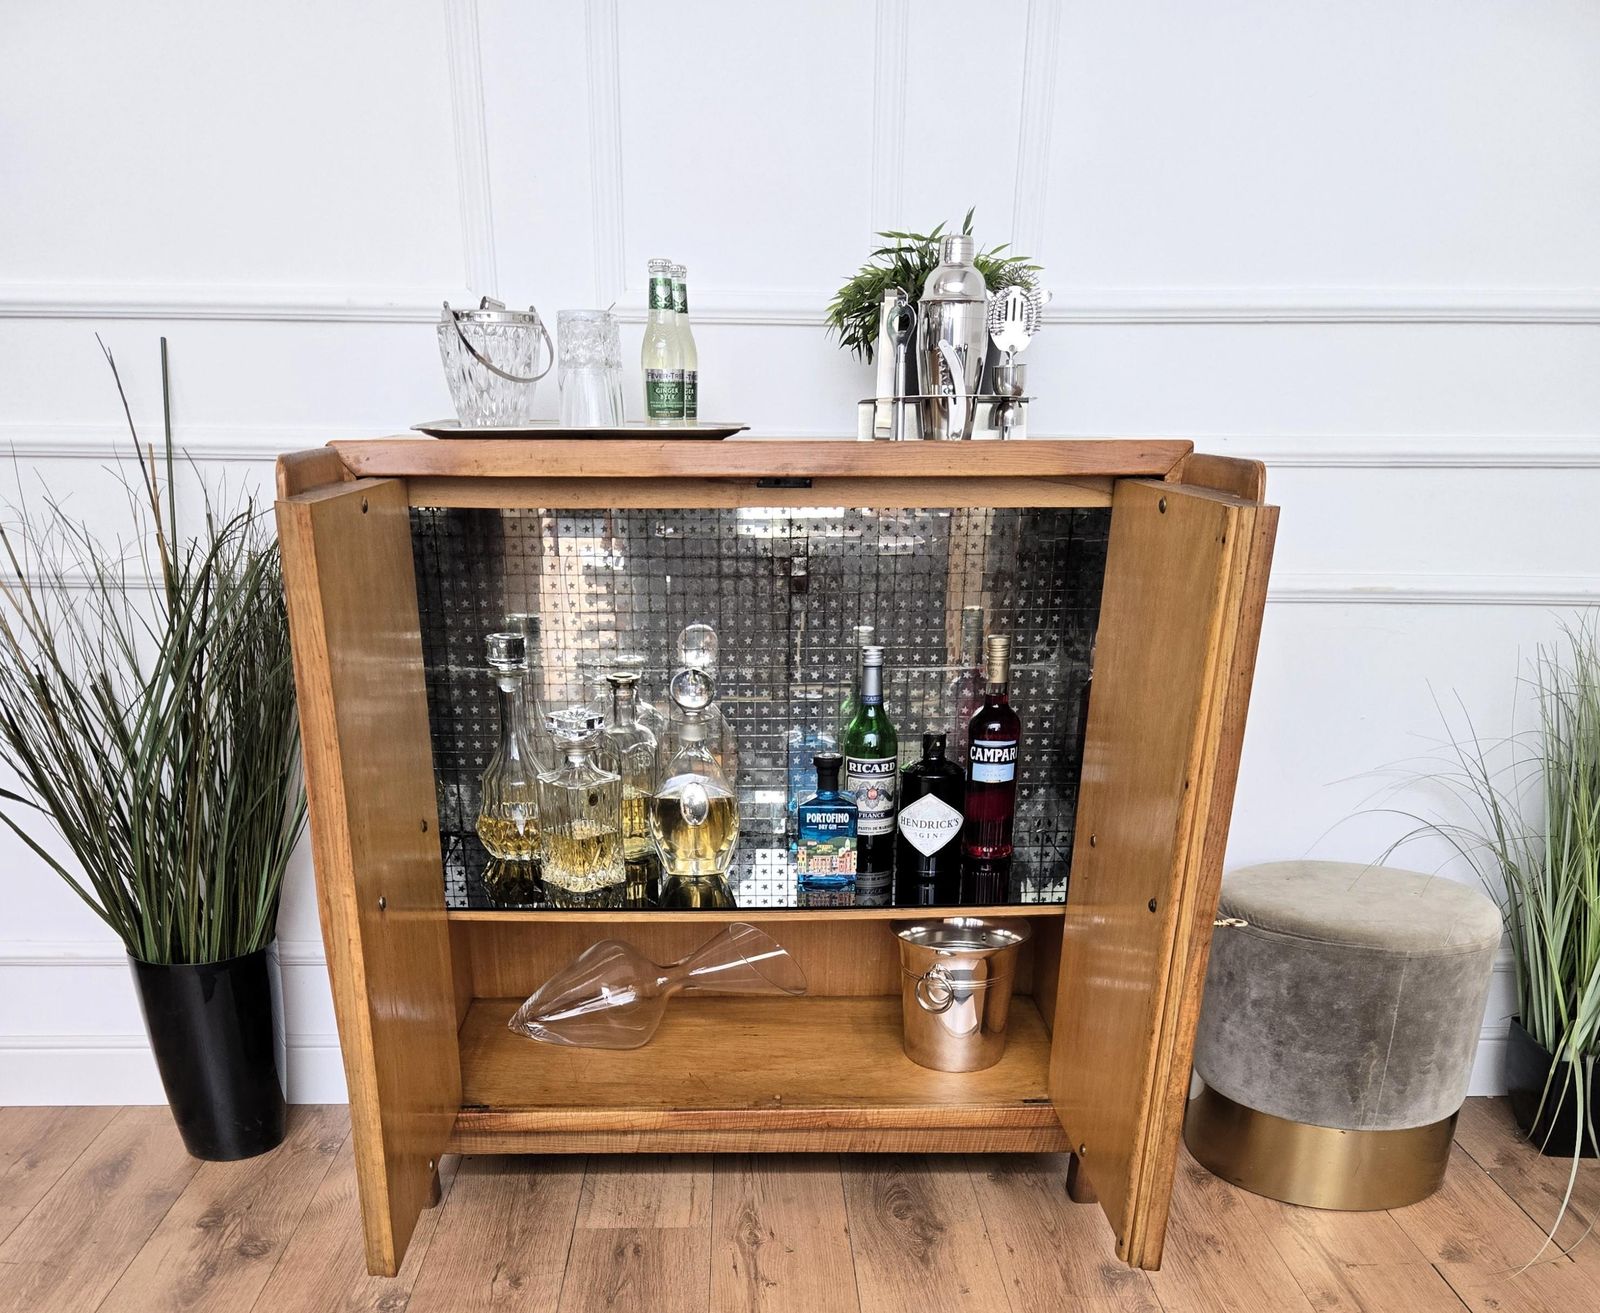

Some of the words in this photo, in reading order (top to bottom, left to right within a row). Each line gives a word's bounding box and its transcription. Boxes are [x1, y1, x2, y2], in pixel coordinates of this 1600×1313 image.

[970, 746, 1018, 762] CAMPARI
[848, 761, 895, 773] RICARD
[806, 812, 849, 823] PORTOFINO
[900, 815, 960, 830] HENDRICK'S
